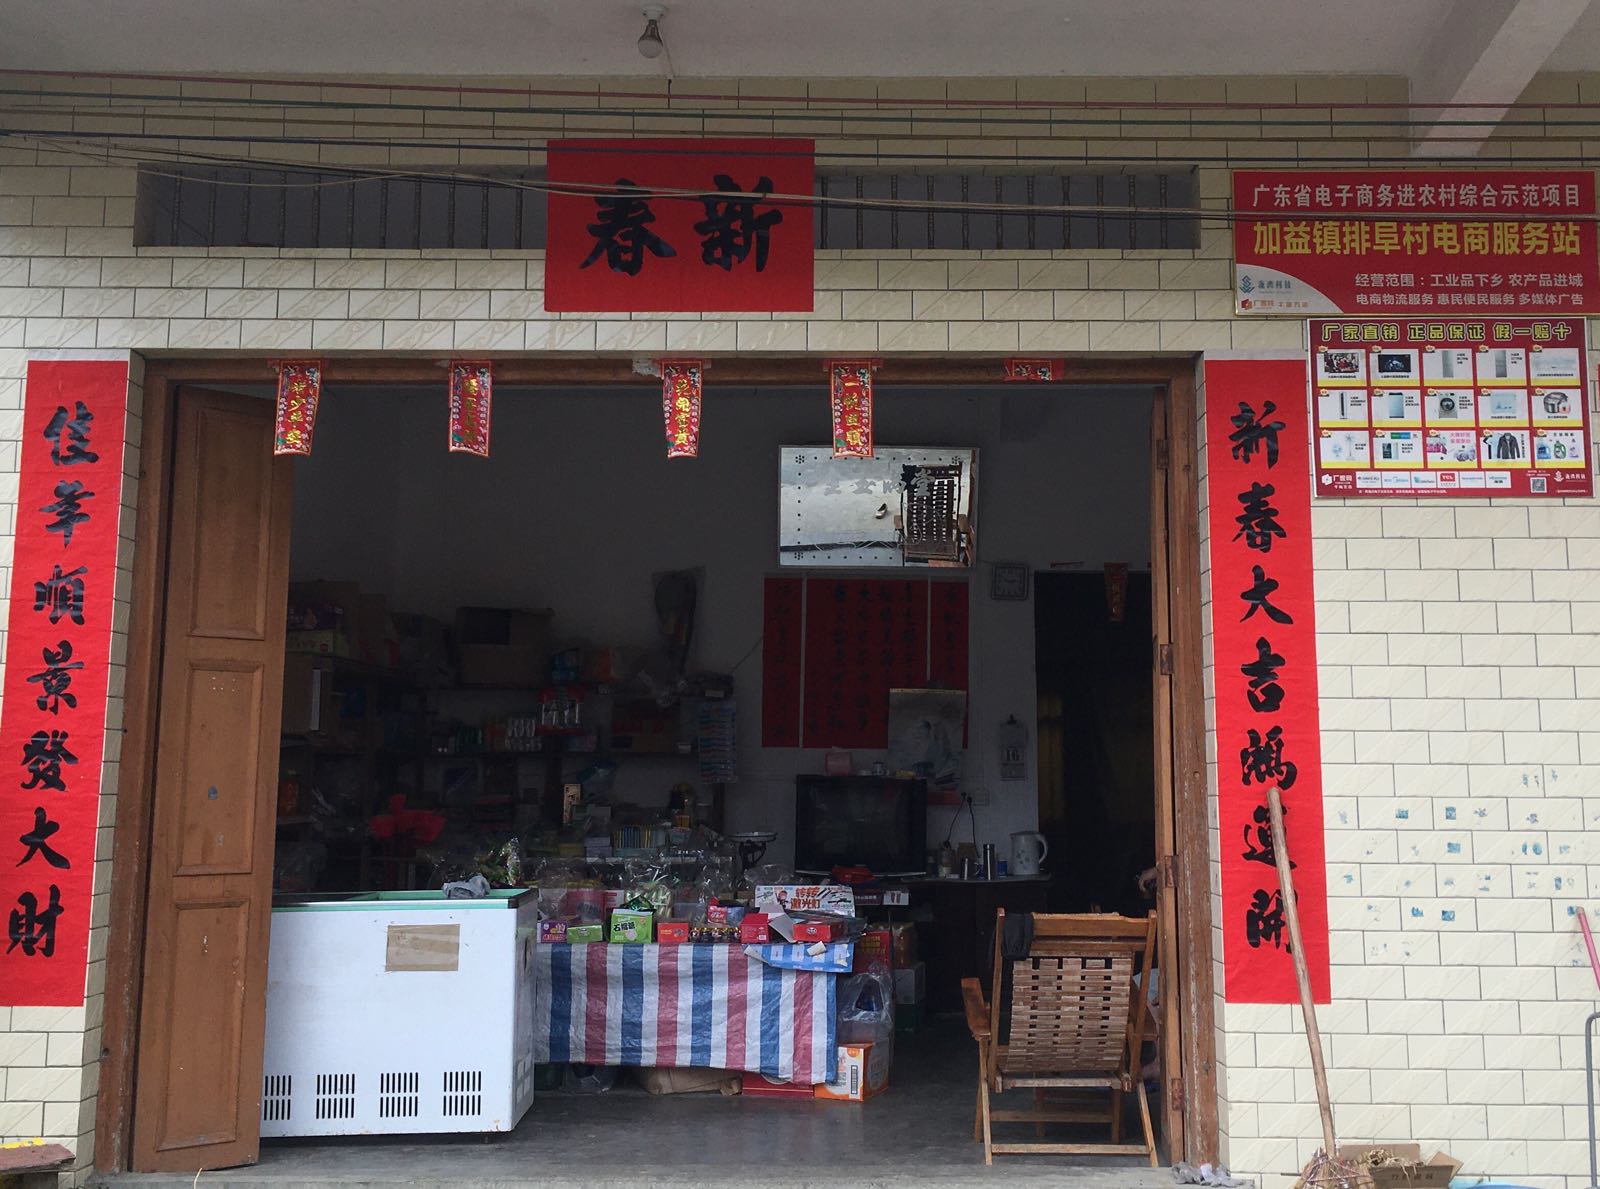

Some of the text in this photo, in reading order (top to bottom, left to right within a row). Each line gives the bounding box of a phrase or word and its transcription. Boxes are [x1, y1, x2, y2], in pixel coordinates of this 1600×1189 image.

[1252, 183, 1580, 208] 广东省电子商务进农村综合示范项目
[1253, 220, 1581, 256] 加益镇排阜村电商服务站
[1508, 273, 1584, 287] 农产品进城
[1356, 293, 1584, 305] 电商物流服务 惠民便民服务 多媒体广告
[1322, 322, 1572, 341] 厂家直销 正品保证 假一赔十
